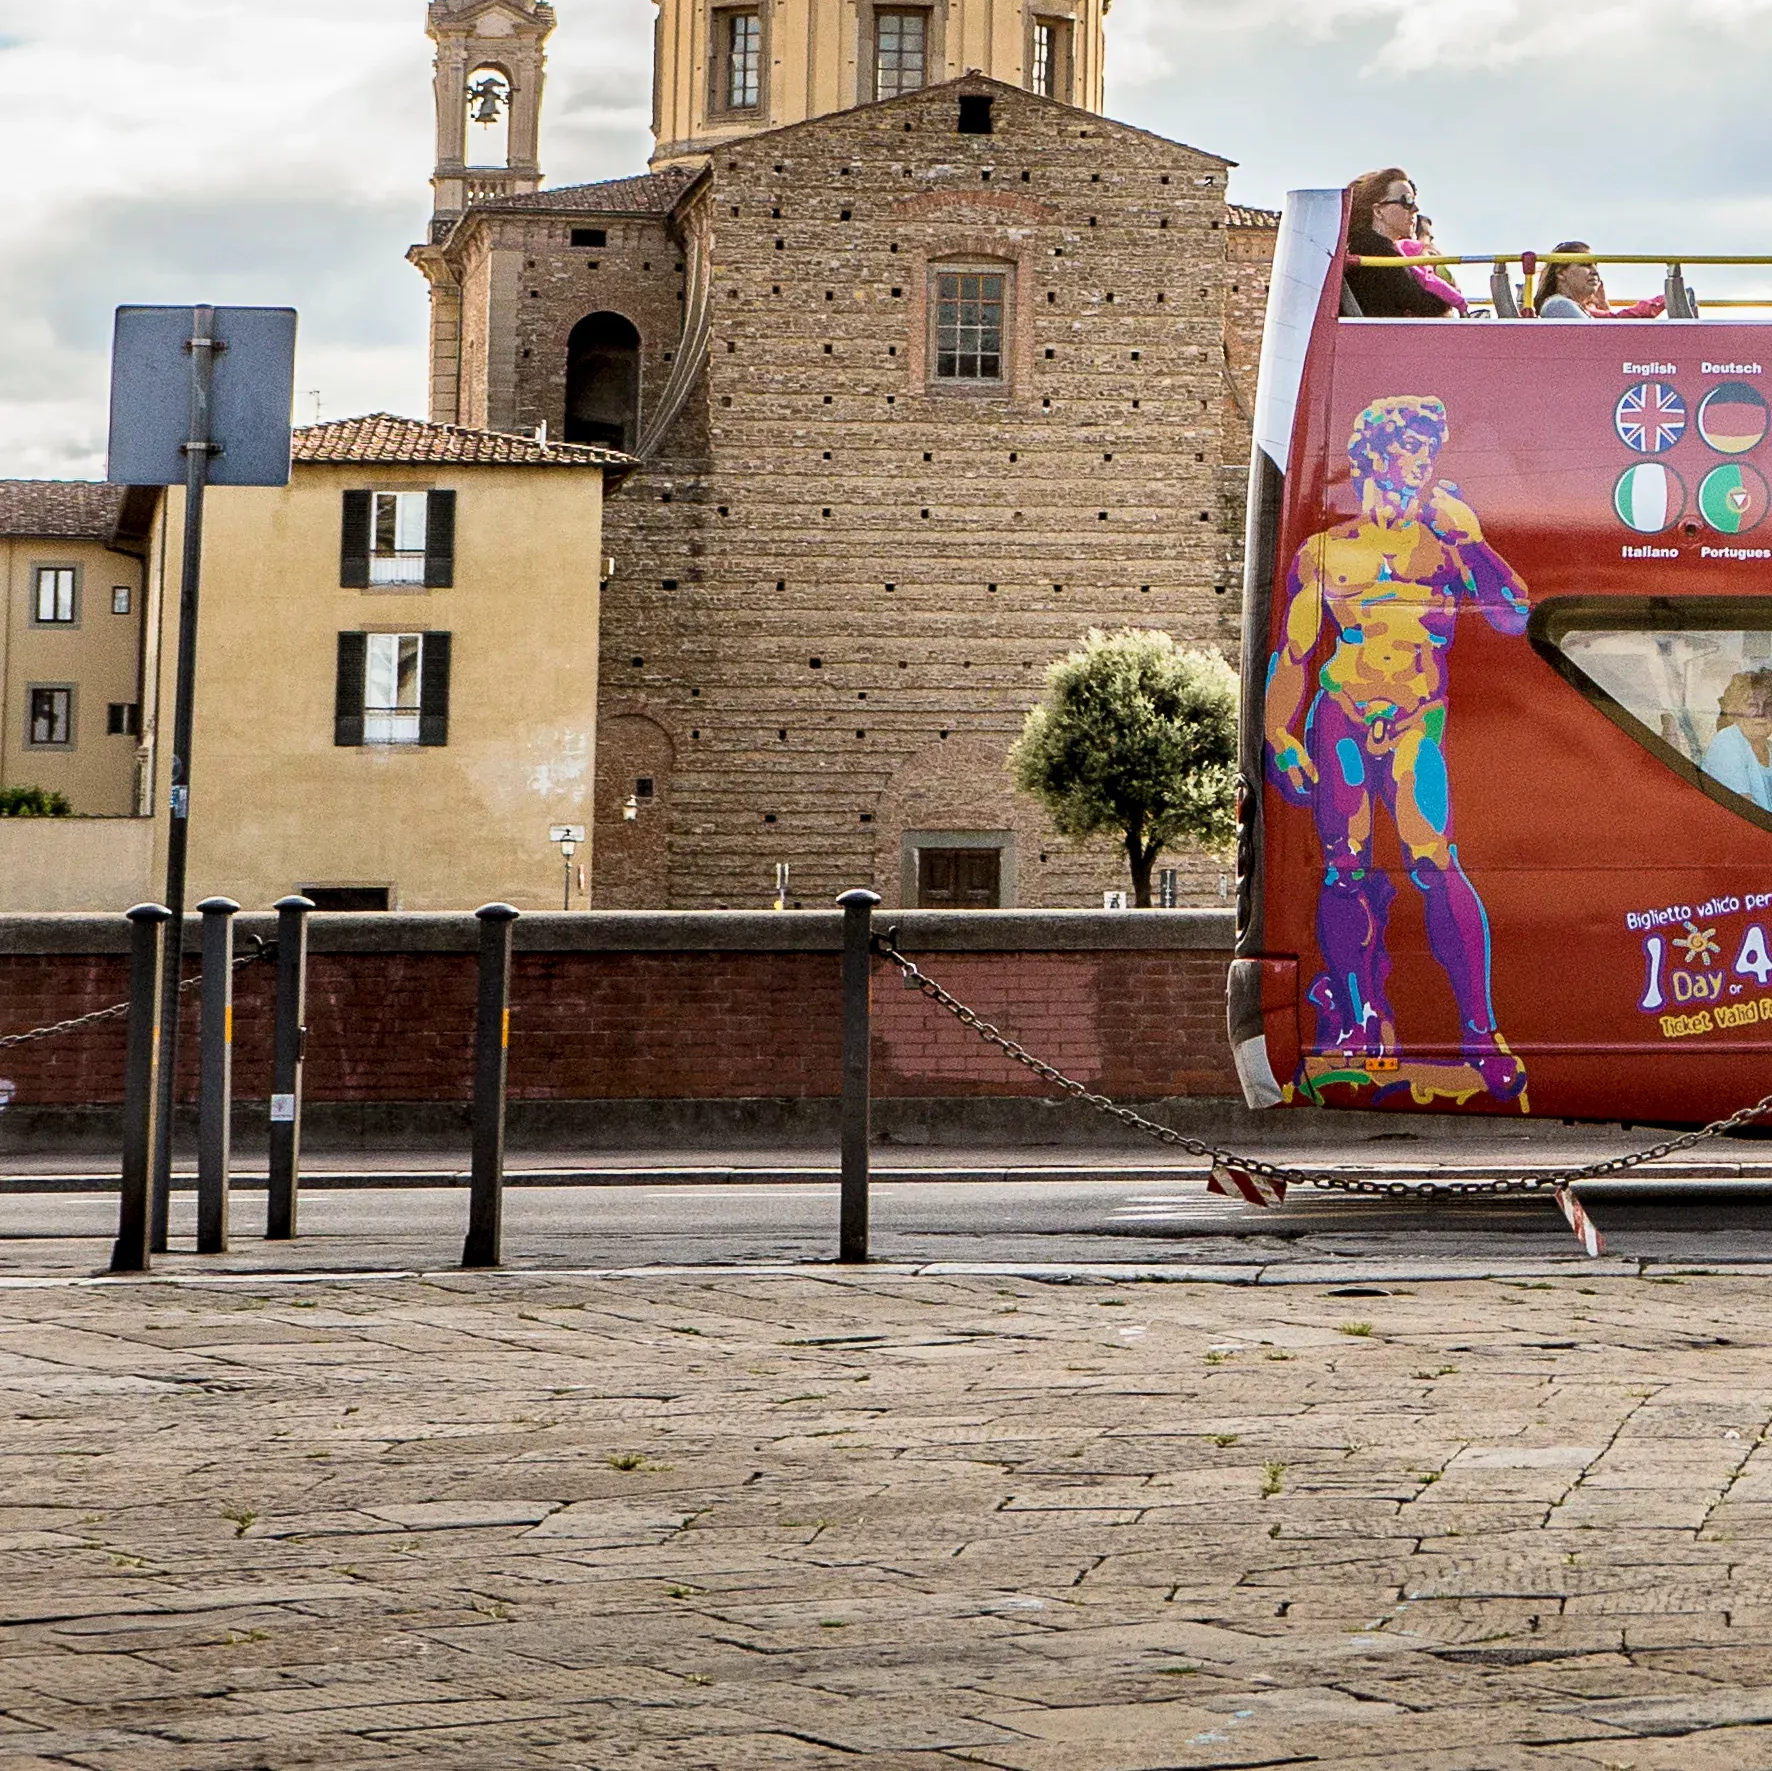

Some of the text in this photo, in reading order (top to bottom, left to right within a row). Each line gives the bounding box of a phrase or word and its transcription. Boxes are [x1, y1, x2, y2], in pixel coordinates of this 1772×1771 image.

[1622, 361, 1677, 376] English
[1700, 361, 1762, 375] Deutsch
[1621, 545, 1679, 559] Italiano
[1627, 906, 1692, 930] Biglietto
[1745, 892, 1772, 908] per
[1641, 936, 1664, 1009] 1
[1672, 971, 1723, 1002] Day
[1729, 983, 1743, 995] or
[1660, 1011, 1713, 1037] Ticket
[1715, 1003, 1757, 1027] Valid
